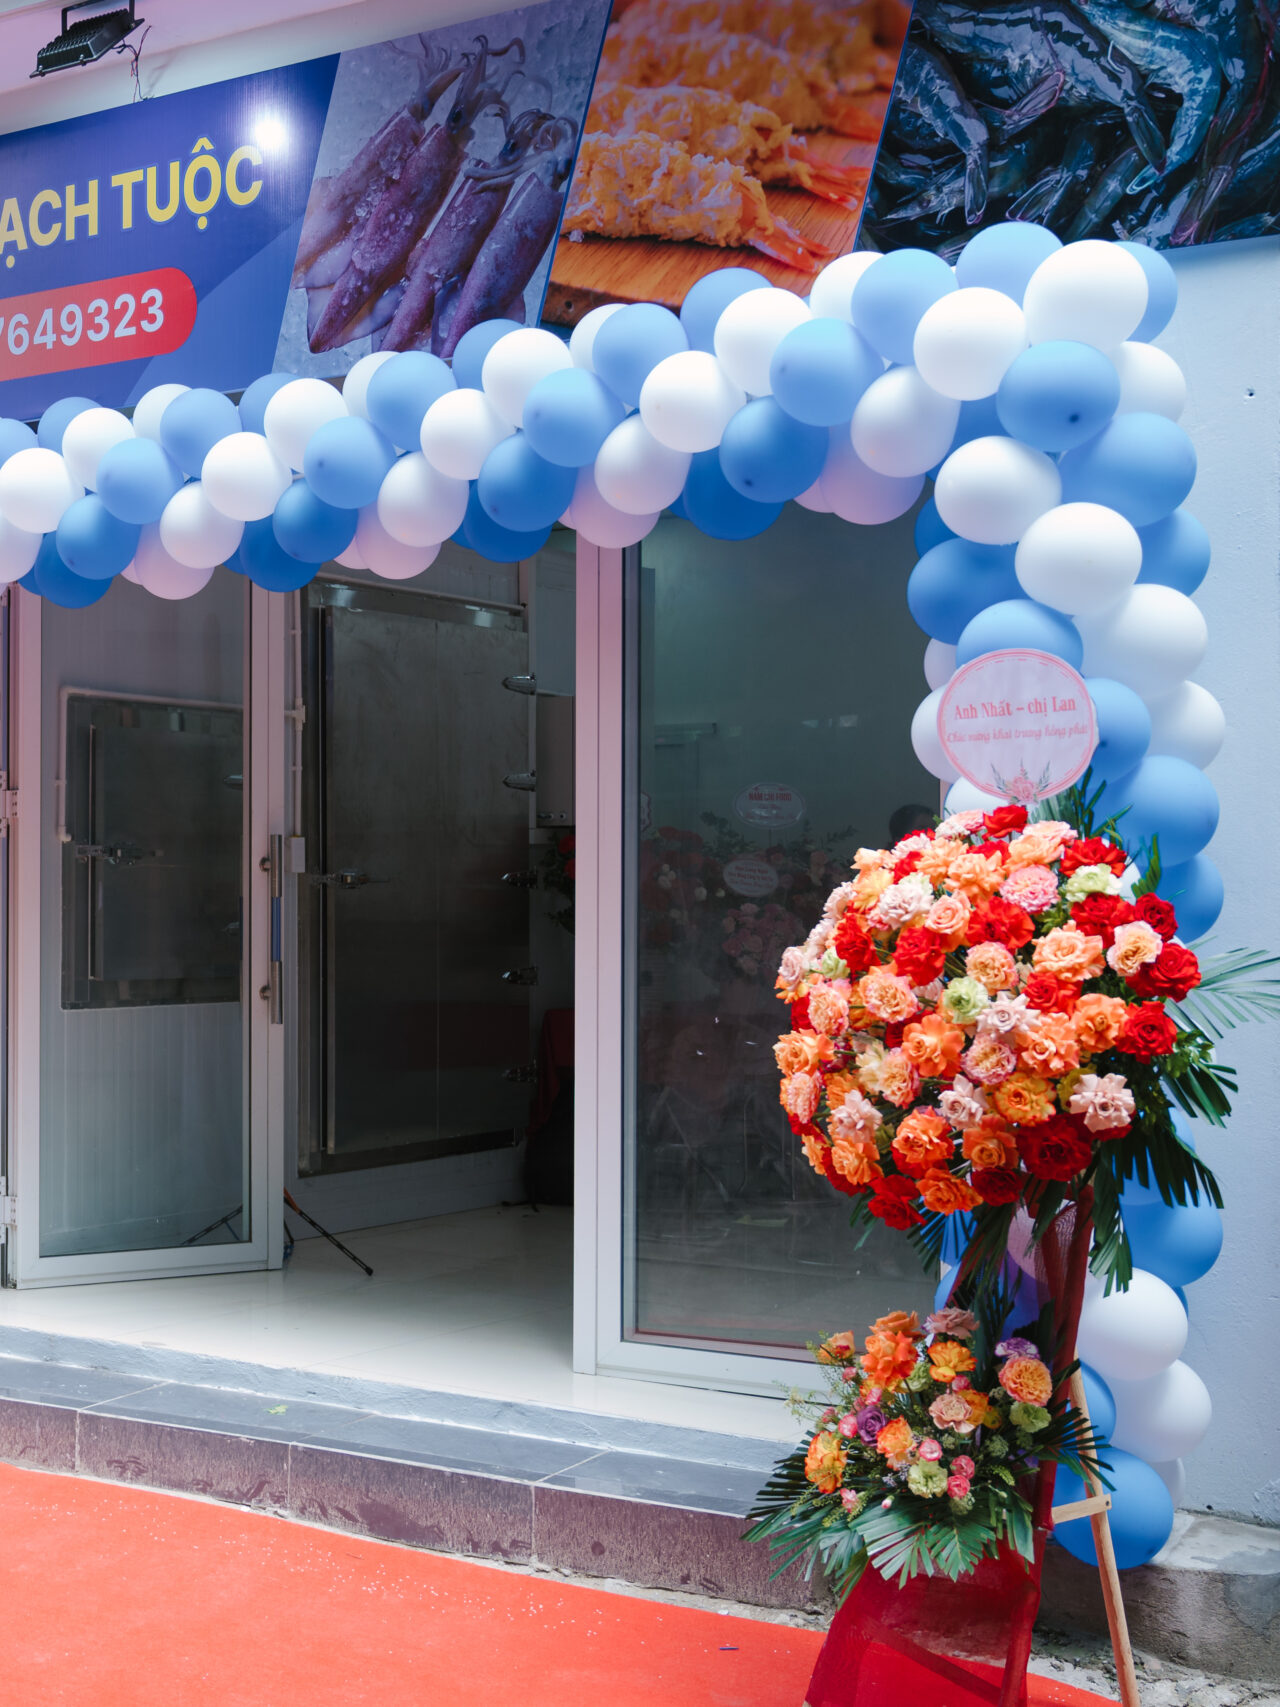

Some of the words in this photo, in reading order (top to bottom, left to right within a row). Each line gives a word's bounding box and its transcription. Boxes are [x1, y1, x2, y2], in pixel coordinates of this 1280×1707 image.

[111, 137, 263, 230] TUỘC
[954, 703, 978, 720] Anh
[981, 700, 1012, 719] Nhất
[1028, 698, 1048, 717] chị
[1052, 696, 1077, 712] Lan
